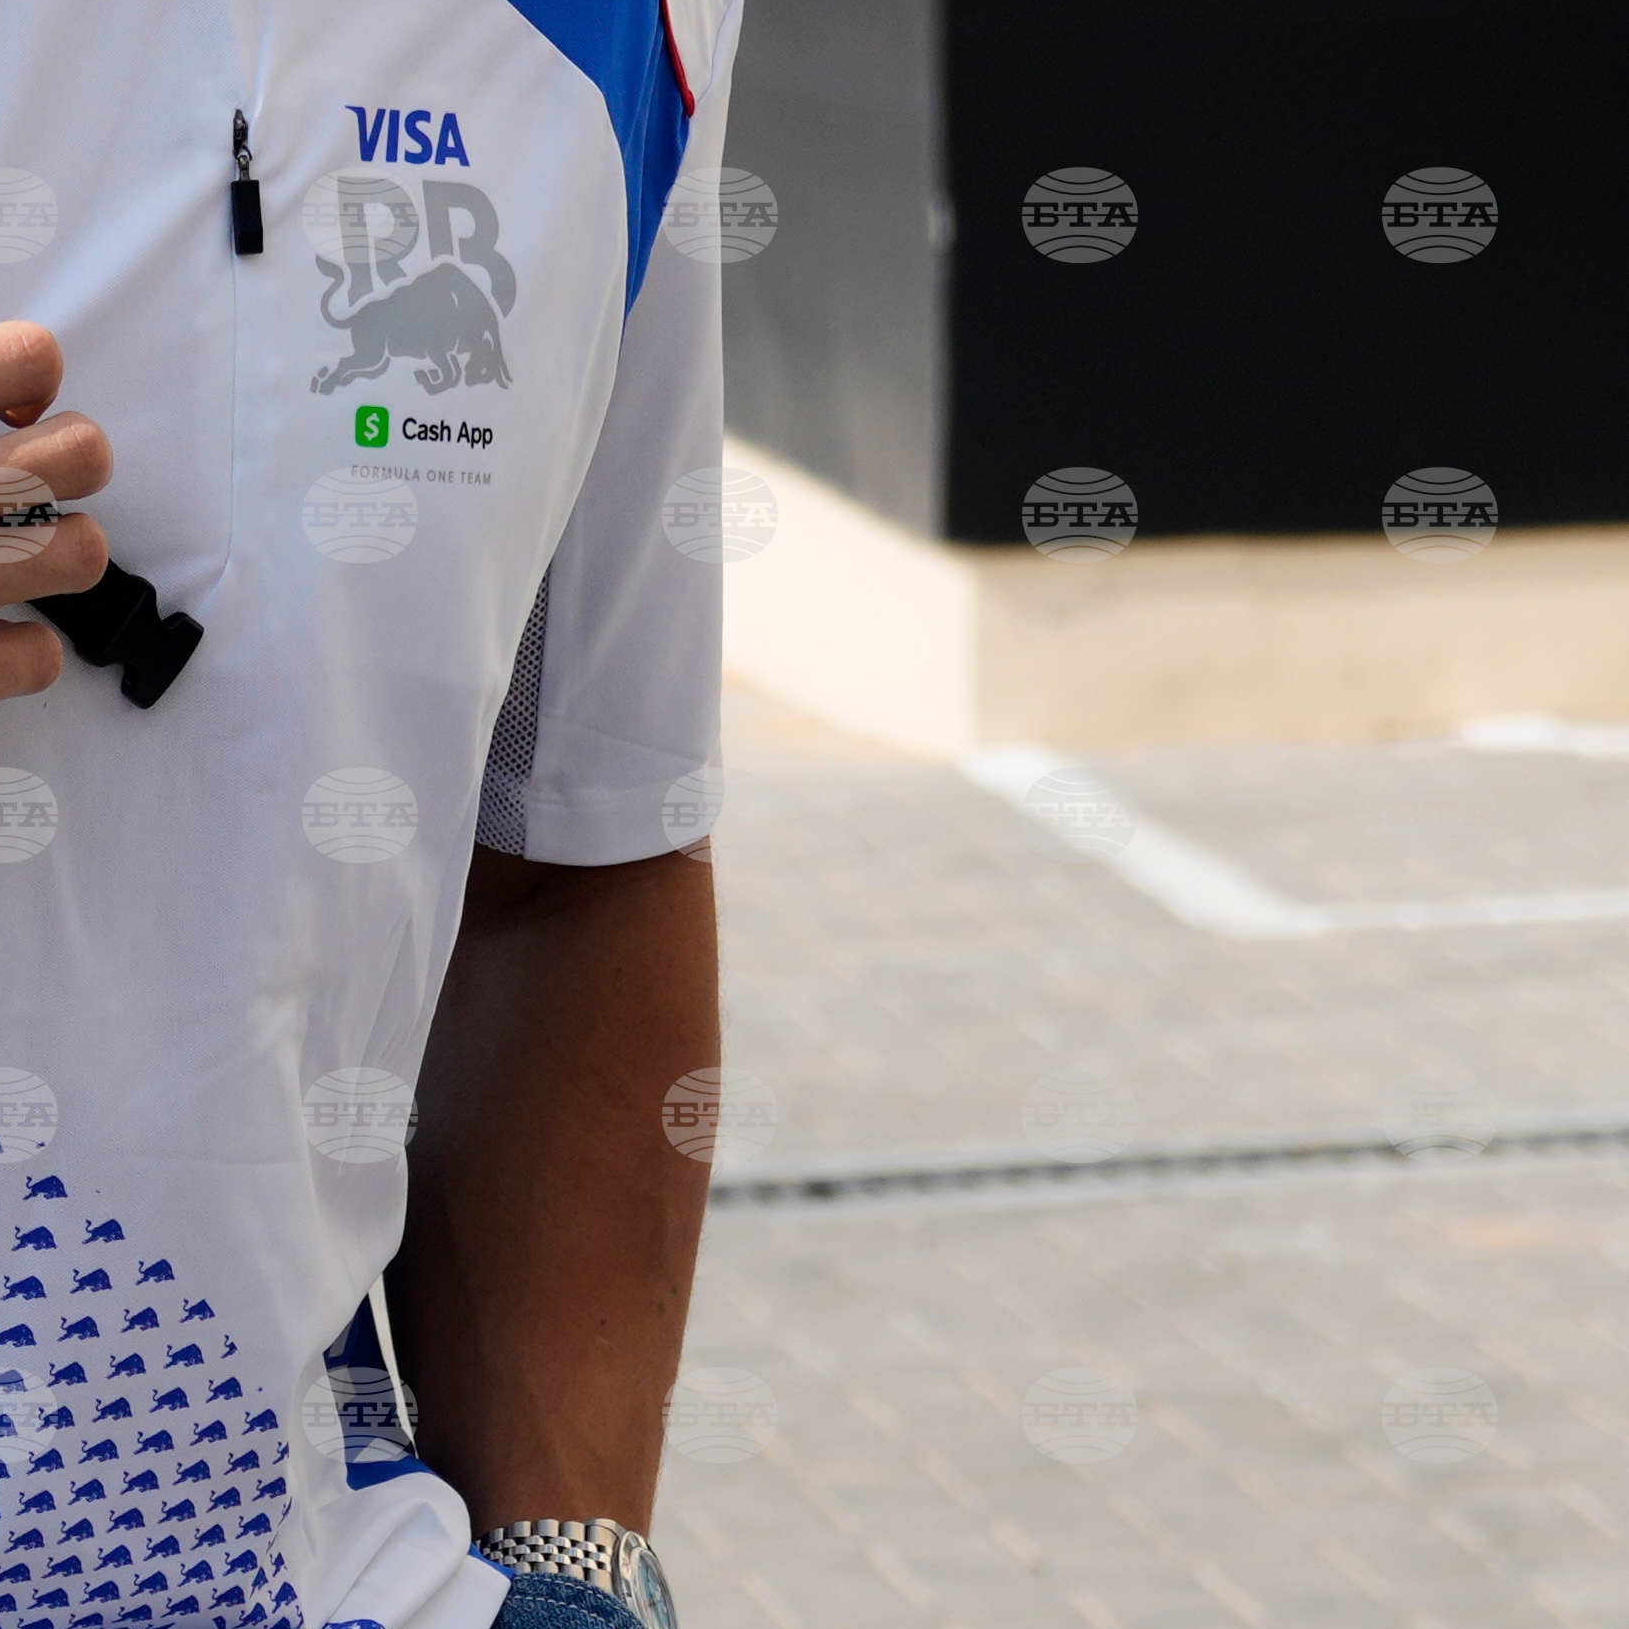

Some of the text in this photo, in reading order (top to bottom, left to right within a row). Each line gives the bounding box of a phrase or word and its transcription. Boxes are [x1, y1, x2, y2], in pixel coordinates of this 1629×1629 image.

[344, 104, 471, 167] VISA
[402, 417, 452, 443] Cash
[457, 421, 494, 450] App
[351, 465, 492, 486] FORMULA ONE TEAM
